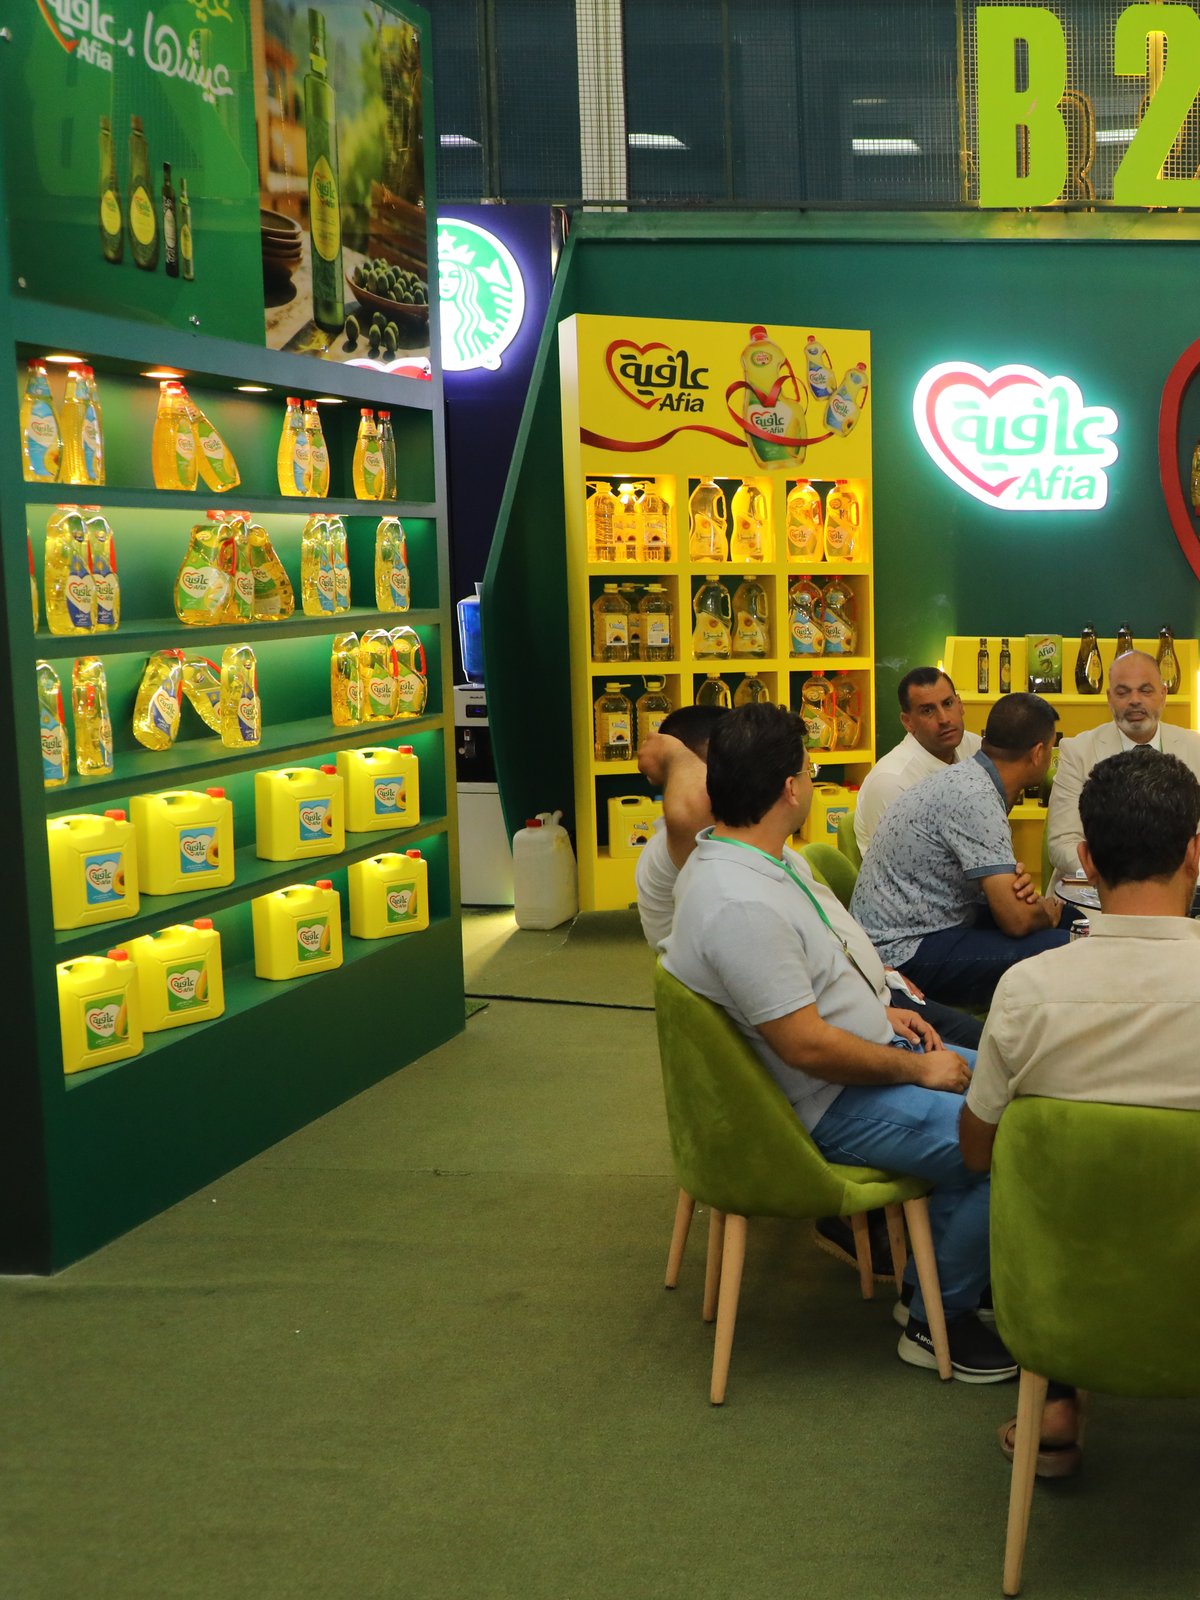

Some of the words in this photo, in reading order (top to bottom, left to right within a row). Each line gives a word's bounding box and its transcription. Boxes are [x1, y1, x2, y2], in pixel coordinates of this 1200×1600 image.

[77, 36, 113, 72] Afia
[619, 350, 709, 397] عافية
[658, 393, 705, 413] Afia
[755, 412, 785, 431] عافية
[951, 386, 1105, 473] عافية
[1016, 465, 1097, 501] Afia
[1038, 643, 1054, 657] Afia
